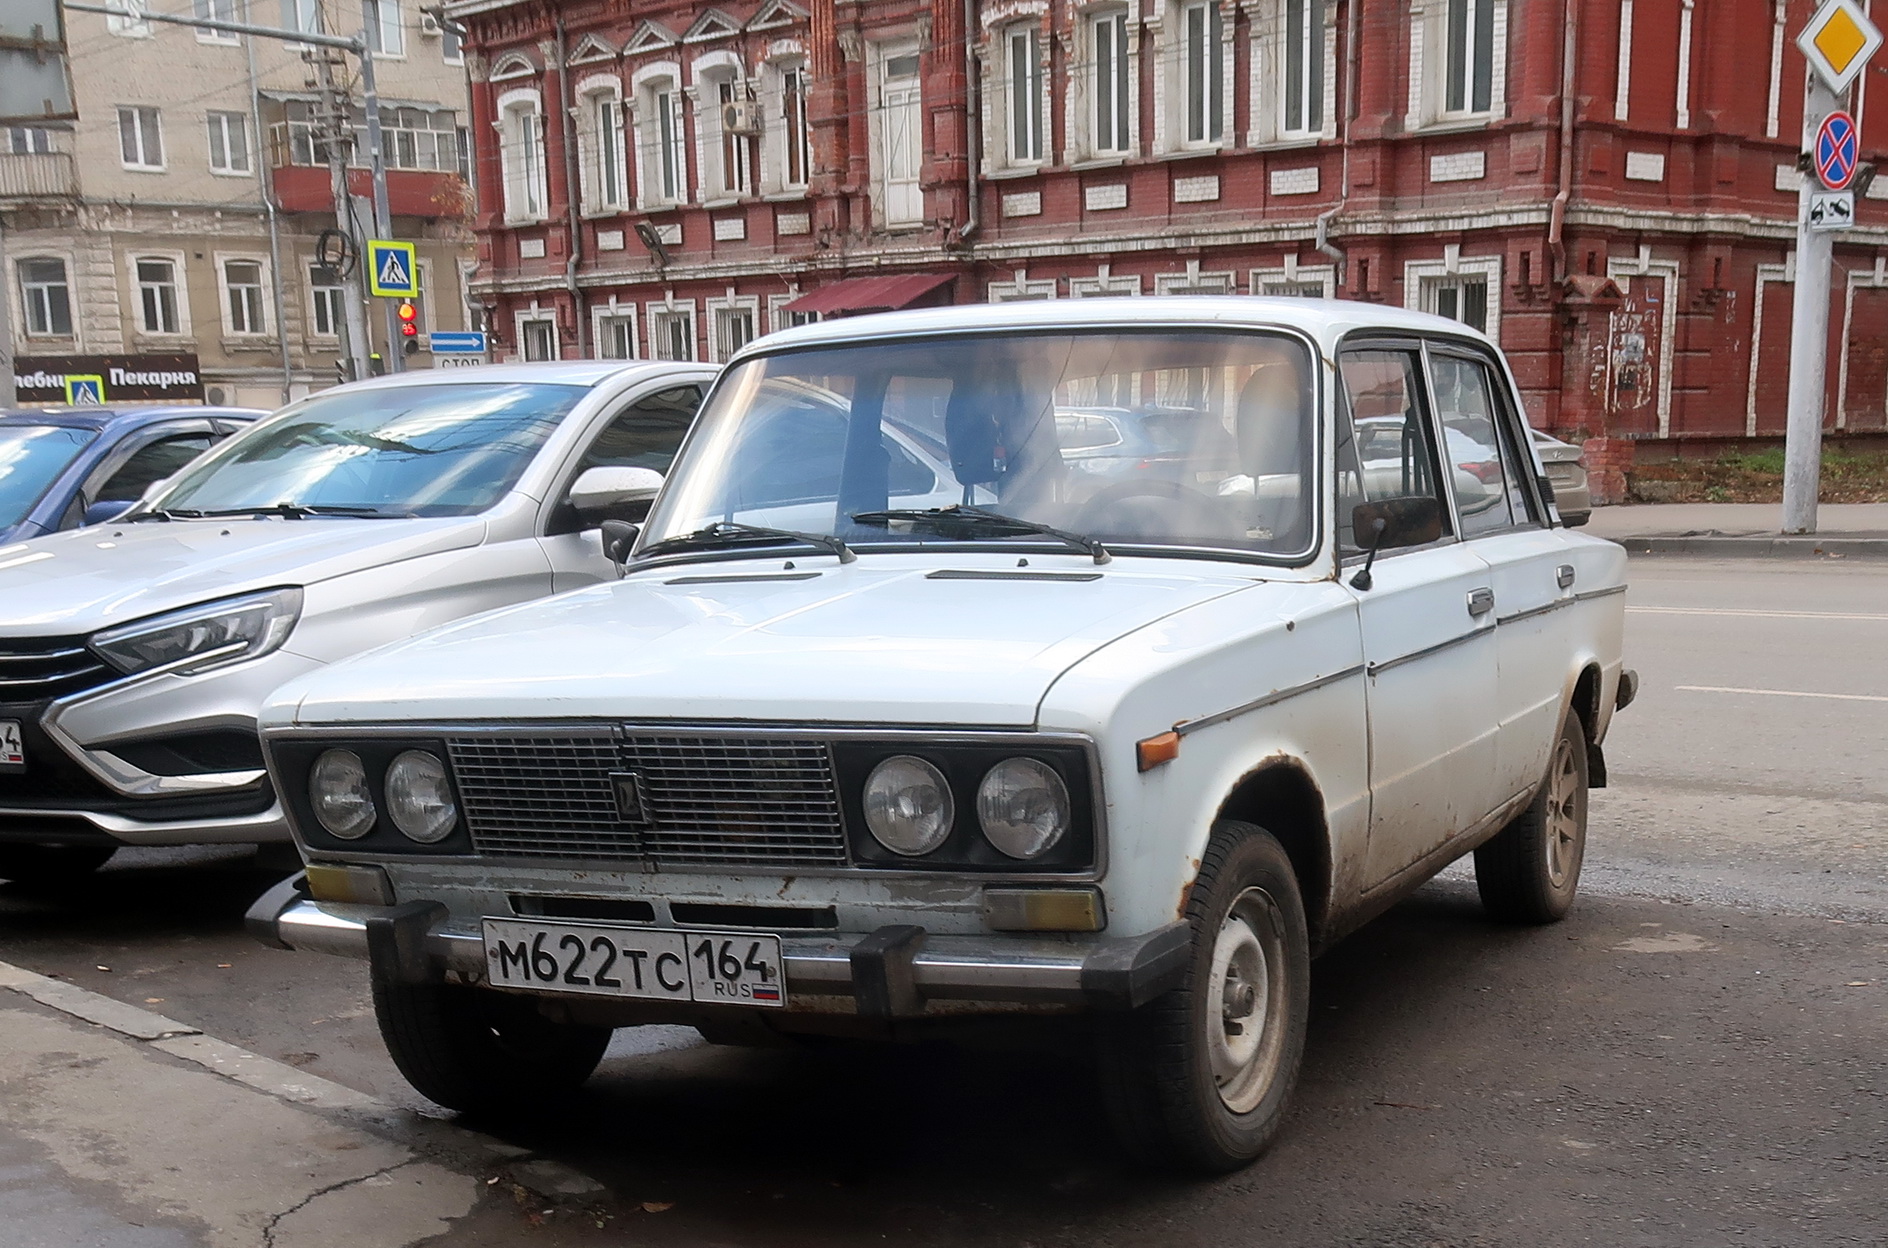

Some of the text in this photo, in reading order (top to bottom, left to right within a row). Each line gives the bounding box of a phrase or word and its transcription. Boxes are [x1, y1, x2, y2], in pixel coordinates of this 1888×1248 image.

[109, 368, 196, 389] Пекарня
[497, 932, 767, 992] М622ТС 164
[715, 981, 750, 997] RUS
